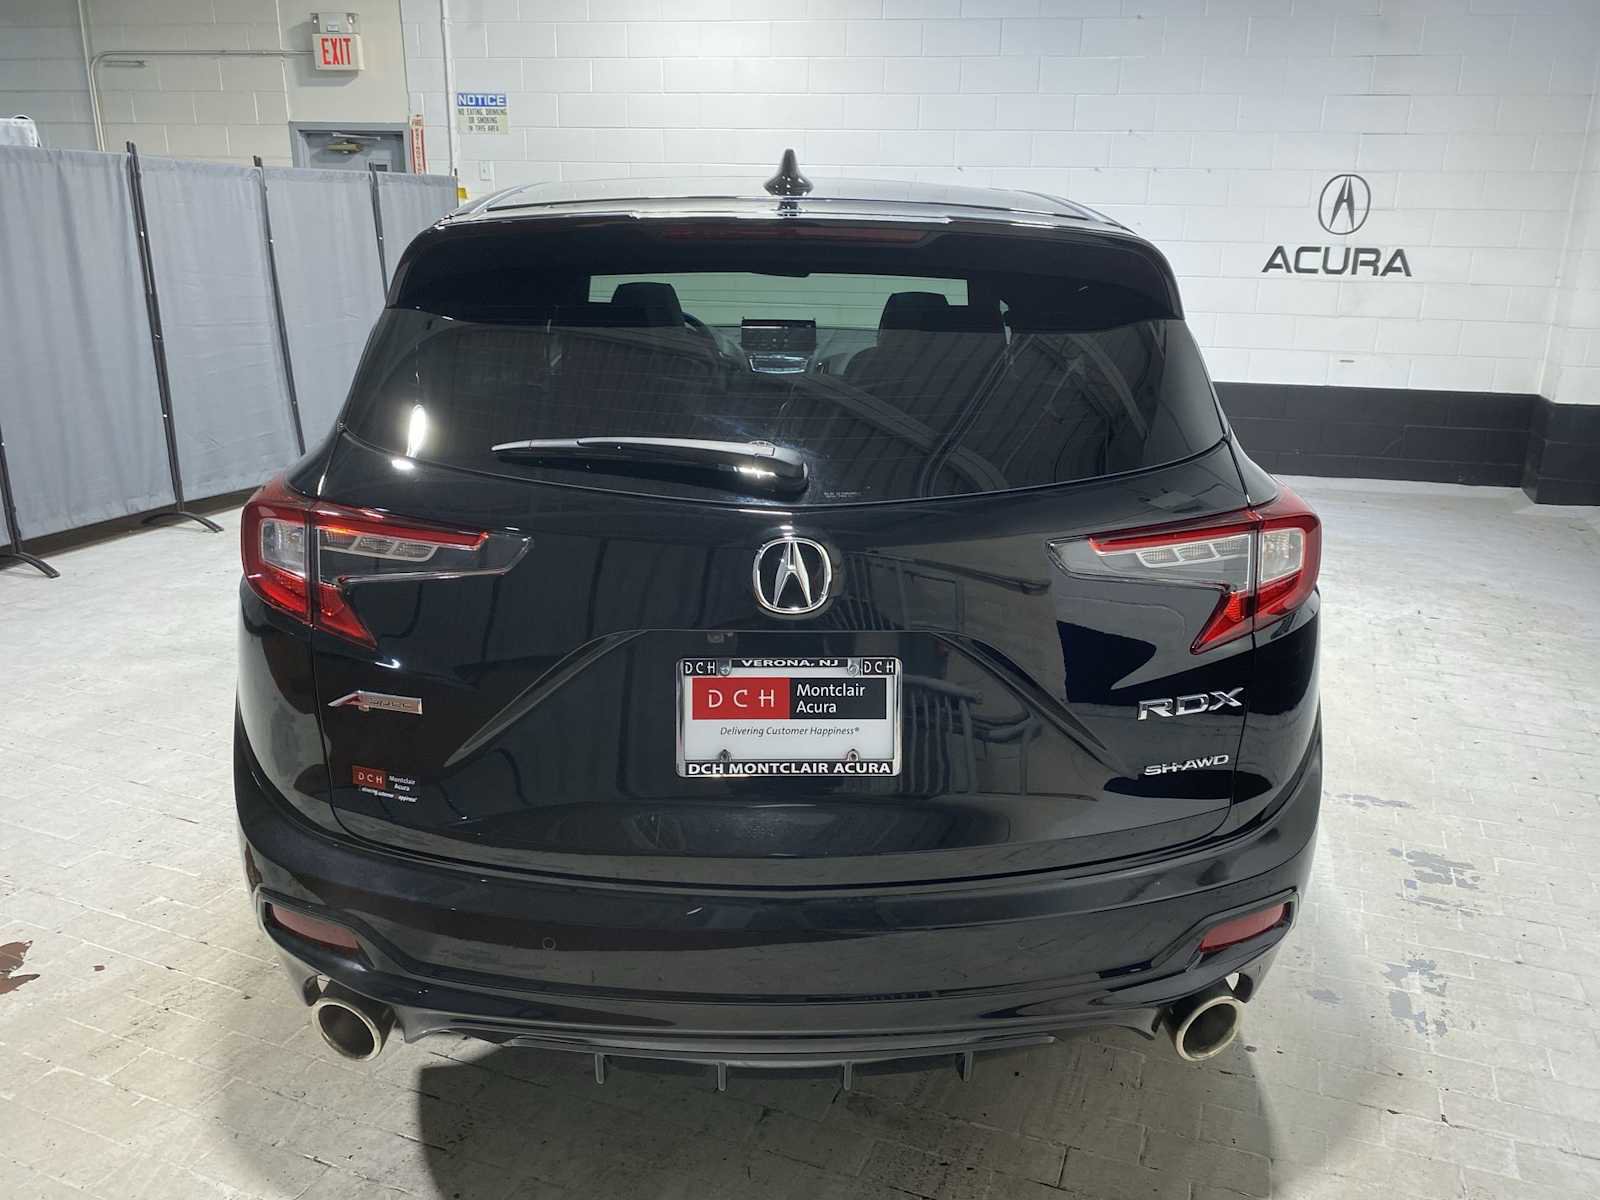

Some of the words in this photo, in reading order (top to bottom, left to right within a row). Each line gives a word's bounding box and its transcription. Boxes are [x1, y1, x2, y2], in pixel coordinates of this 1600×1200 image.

[321, 38, 351, 65] EXIT
[457, 95, 505, 106] NOTICE
[1261, 245, 1413, 277] ACURA
[684, 661, 716, 674] DCH
[819, 659, 839, 668] NJ
[863, 660, 895, 673] DCH
[796, 683, 865, 697] Montclair
[708, 689, 775, 708] DCH
[1138, 687, 1244, 720] RDX
[796, 701, 837, 713] Acura
[720, 726, 764, 737] Delivering
[766, 726, 808, 735] Customer
[688, 763, 724, 774] DCH
[729, 762, 829, 774] MONTCLAIR
[833, 762, 891, 774] ACURA
[1144, 754, 1229, 776] SH-AWD
[358, 771, 383, 784] DCH
